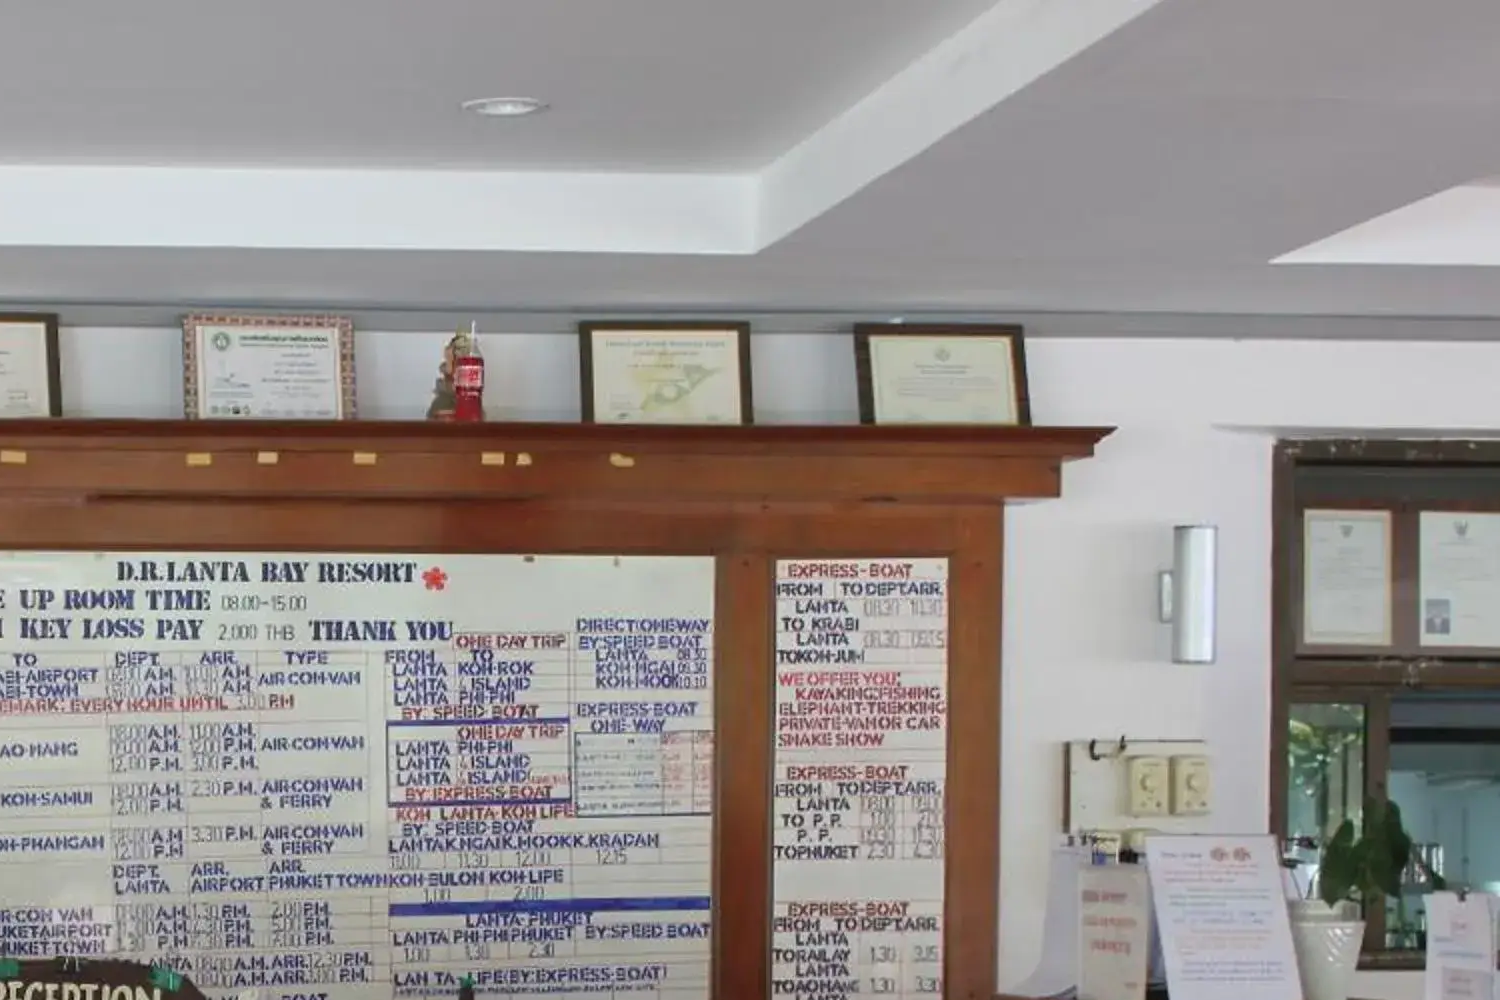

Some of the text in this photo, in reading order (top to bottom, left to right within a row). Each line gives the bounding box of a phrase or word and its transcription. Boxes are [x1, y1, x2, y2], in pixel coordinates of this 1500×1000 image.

[260, 561, 309, 583] BAY
[316, 561, 418, 583] RESORT
[777, 582, 823, 598] FROM
[840, 582, 863, 597] TO
[20, 588, 55, 611] UP
[64, 588, 136, 611] ROOM
[145, 589, 212, 611] TIME
[795, 600, 850, 615] LANTA
[19, 618, 72, 641] KEY
[82, 618, 146, 640] LOSS
[156, 618, 205, 641] PAY
[265, 624, 296, 641] THB
[308, 619, 398, 642] THANK
[405, 620, 454, 642] YOU
[781, 617, 860, 632] TO KRABI
[456, 633, 566, 650] ONE DAY TRIP
[658, 634, 703, 650] BOAT
[795, 632, 850, 647] LANTA
[12, 652, 39, 668] TO
[284, 651, 330, 666] TYPE
[384, 648, 495, 664] FROM TO
[595, 649, 648, 663] LANTA
[391, 663, 448, 678] LANTA
[393, 676, 531, 693] LANTA ISLAND
[778, 672, 804, 687] WE
[806, 671, 860, 686] OFFER
[69, 698, 125, 714] EVERY
[127, 697, 175, 713] HOUR
[179, 695, 230, 711] UNTIL
[393, 691, 450, 707] LANTA
[905, 717, 942, 731] CAR
[457, 725, 566, 741] ONE DAY TRIP
[778, 733, 886, 748] SNAKE SHOW
[395, 741, 450, 758] LANTA
[396, 754, 532, 772] LANTA ISLAND
[396, 772, 451, 788] LANTA
[775, 781, 822, 798] FROM
[836, 782, 860, 796] TO
[279, 795, 334, 810] FERRY
[796, 797, 851, 812] LANTA
[395, 807, 431, 822] KOH
[781, 813, 805, 828] TO
[280, 840, 335, 856] FERRY
[388, 837, 444, 854] LANTA
[115, 879, 171, 895] LANTA
[190, 876, 265, 894] AIRPORT
[528, 910, 595, 927] PHUKET
[774, 916, 821, 932] FROM
[834, 917, 858, 932] TO
[393, 930, 448, 947] LANTA
[510, 926, 574, 943] PHUKET
[666, 922, 712, 938] BOAT
[795, 932, 850, 947] LANTA
[795, 963, 850, 978] LANTA
